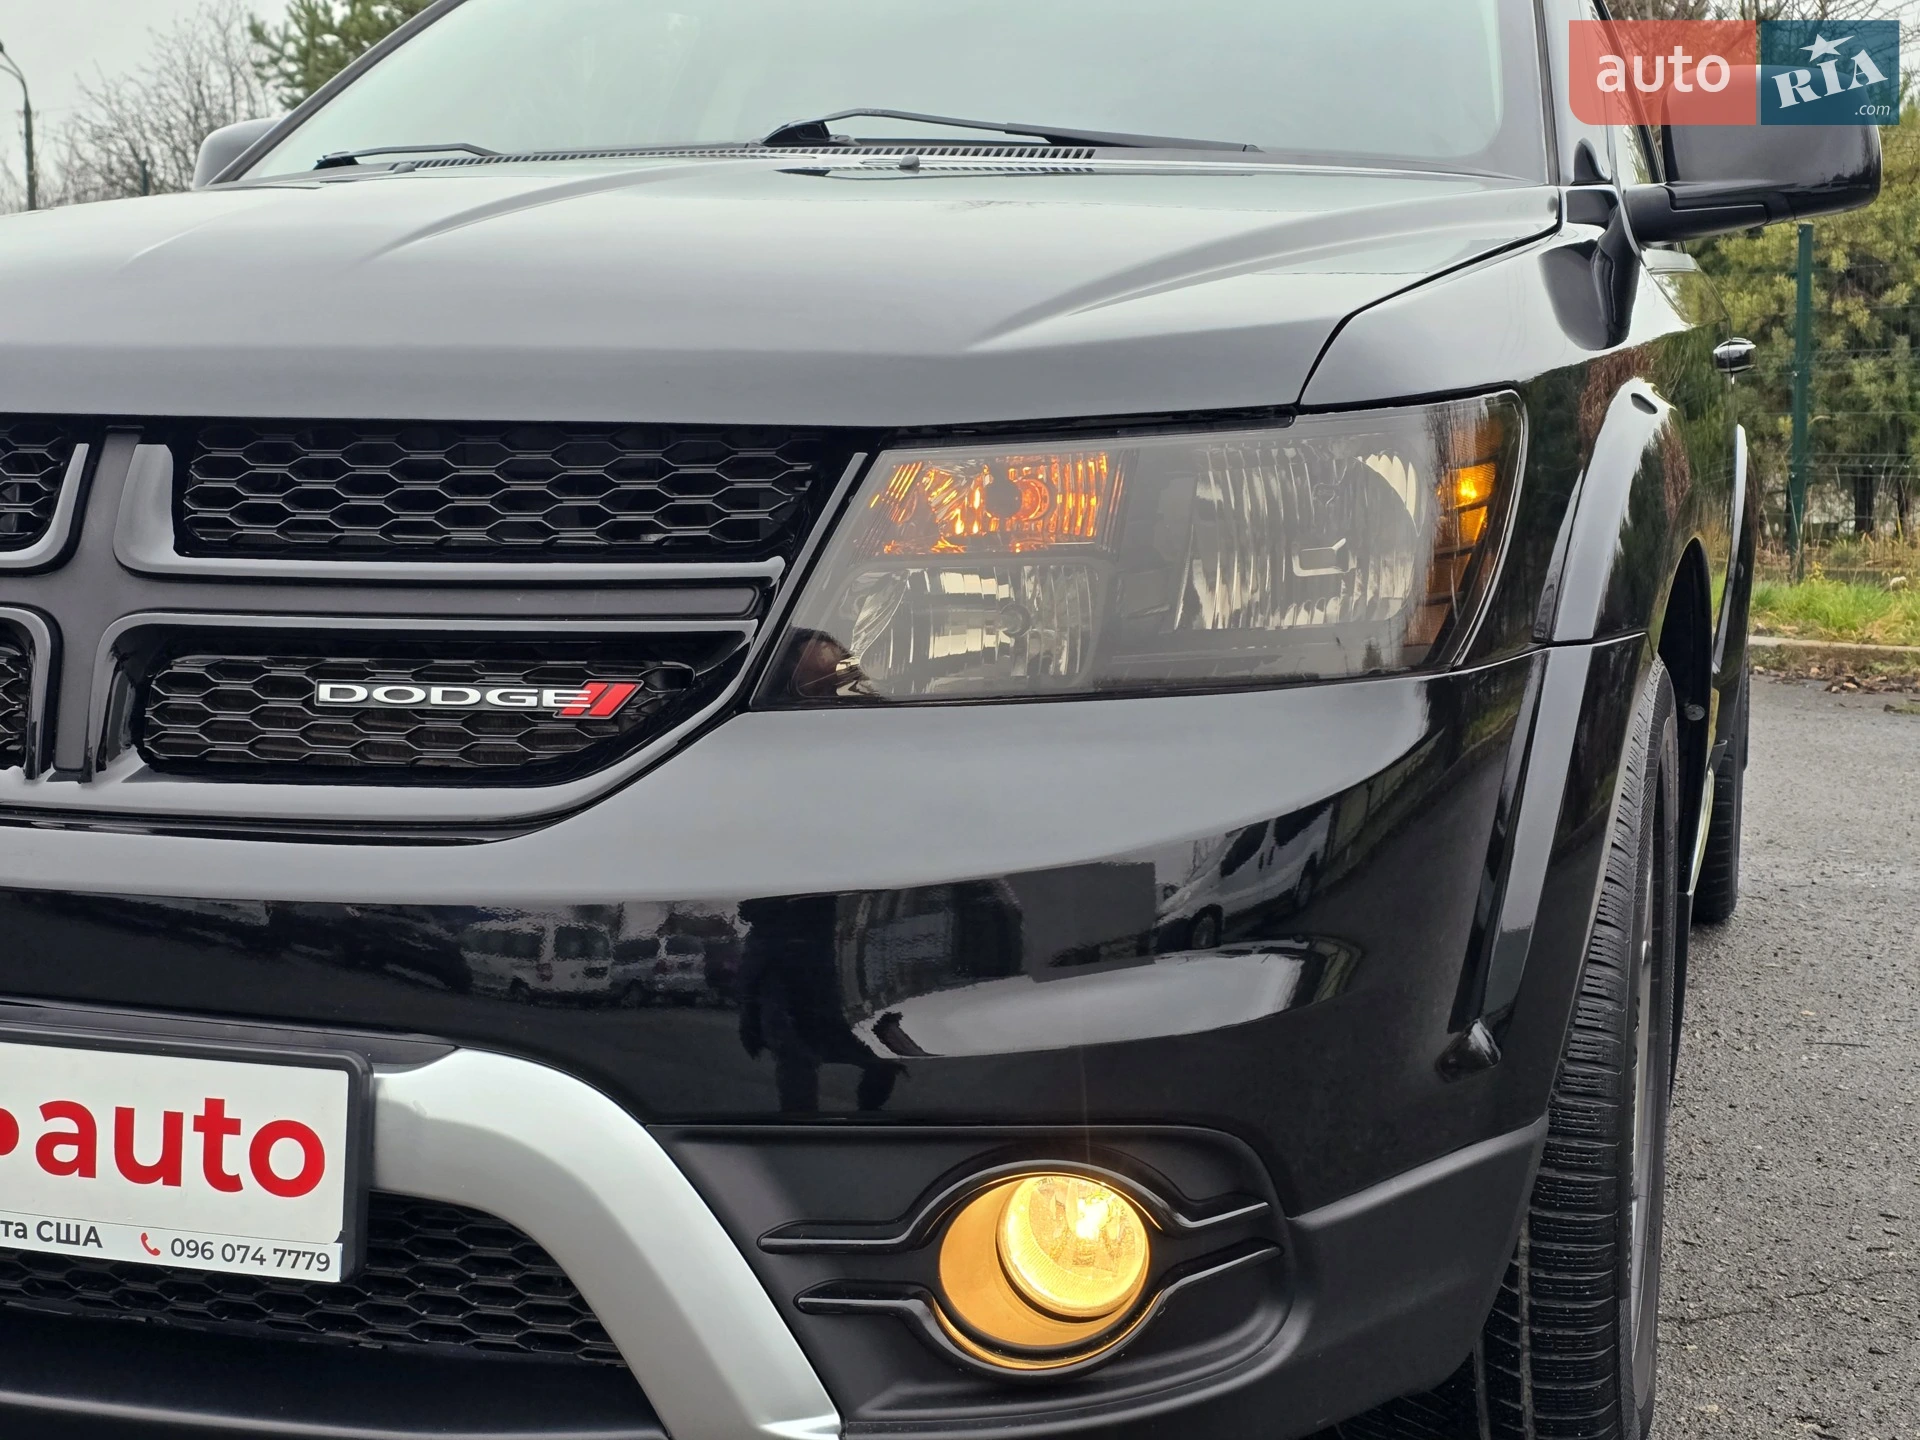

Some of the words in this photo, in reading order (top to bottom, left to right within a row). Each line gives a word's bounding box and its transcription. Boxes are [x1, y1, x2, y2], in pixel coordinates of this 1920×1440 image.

[317, 684, 592, 708] DODGE
[35, 1097, 326, 1198] auto
[36, 1220, 103, 1249] США
[170, 1237, 214, 1260] 096
[221, 1243, 267, 1266] 074
[273, 1248, 331, 1273] 7779
